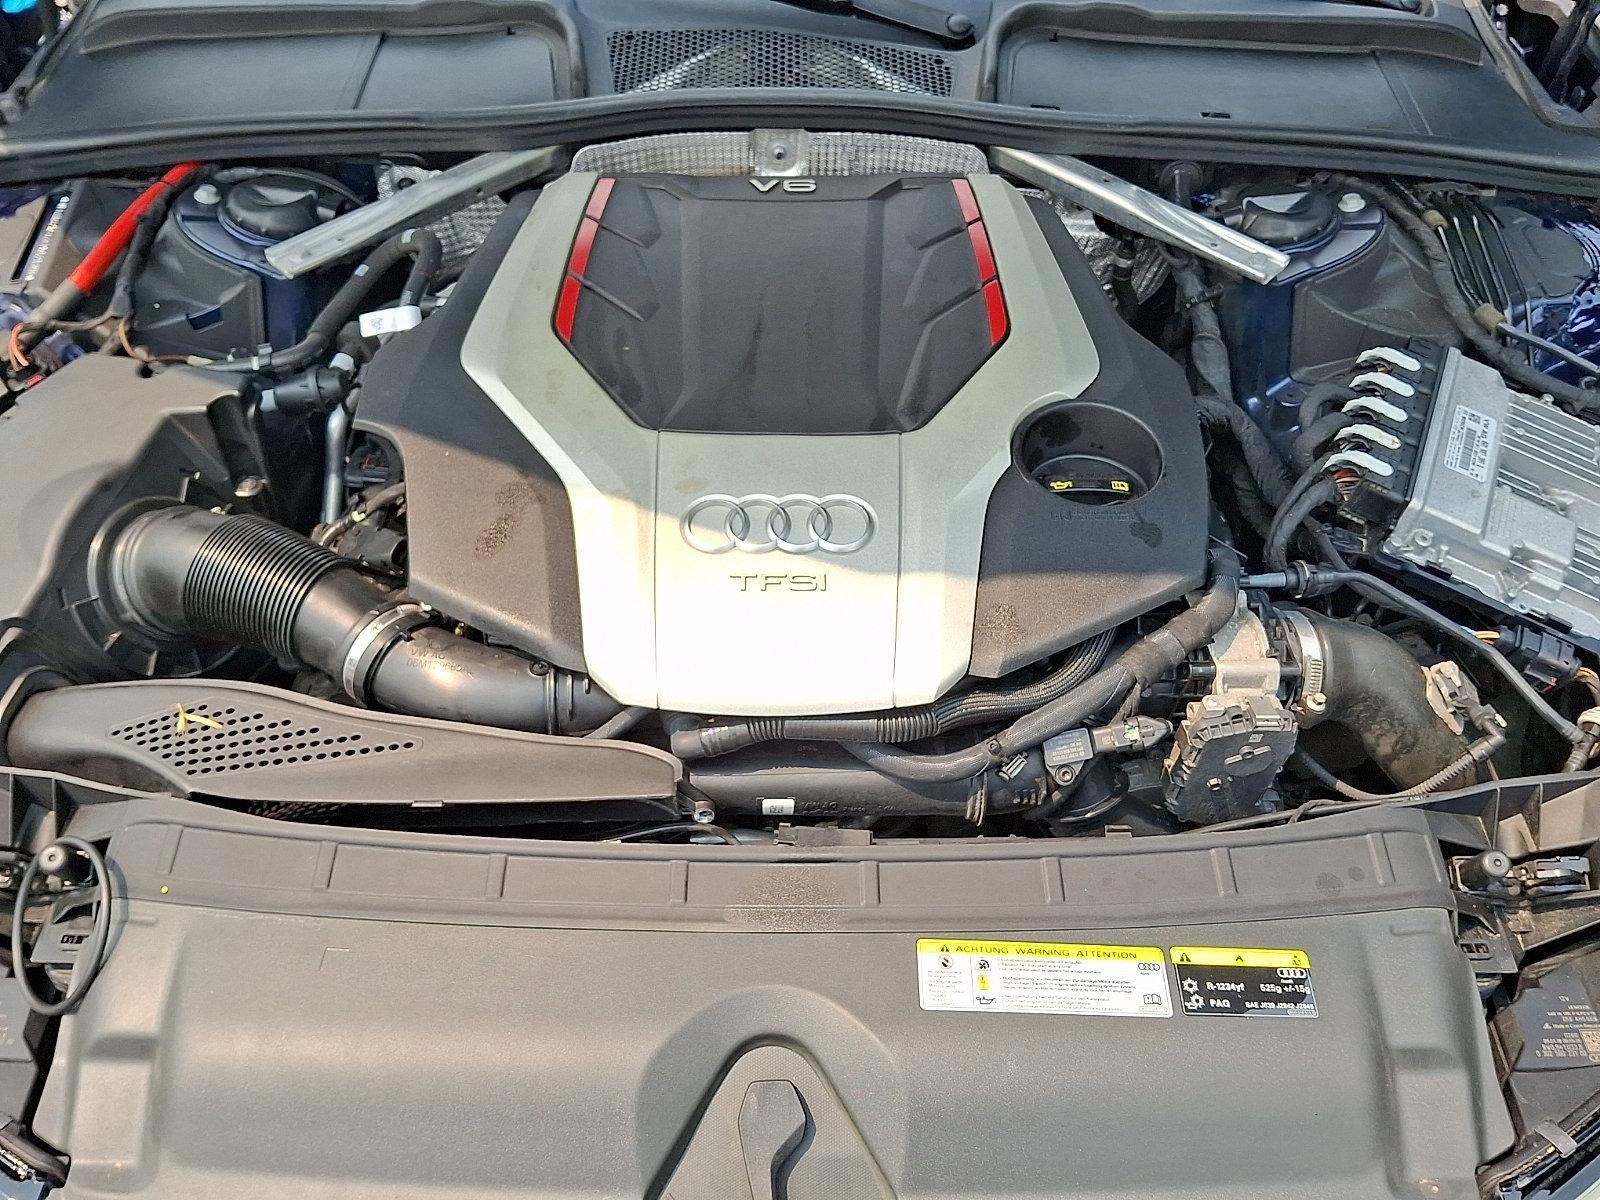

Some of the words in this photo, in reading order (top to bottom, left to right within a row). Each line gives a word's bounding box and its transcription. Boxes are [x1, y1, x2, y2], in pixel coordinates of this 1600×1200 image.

[749, 178, 817, 194] V6
[729, 574, 827, 592] TFSI
[956, 945, 1009, 955] ACHTUNG
[1016, 948, 1070, 957] WARNING
[1076, 950, 1137, 959] ATTENTION
[1209, 998, 1231, 1008] PAG
